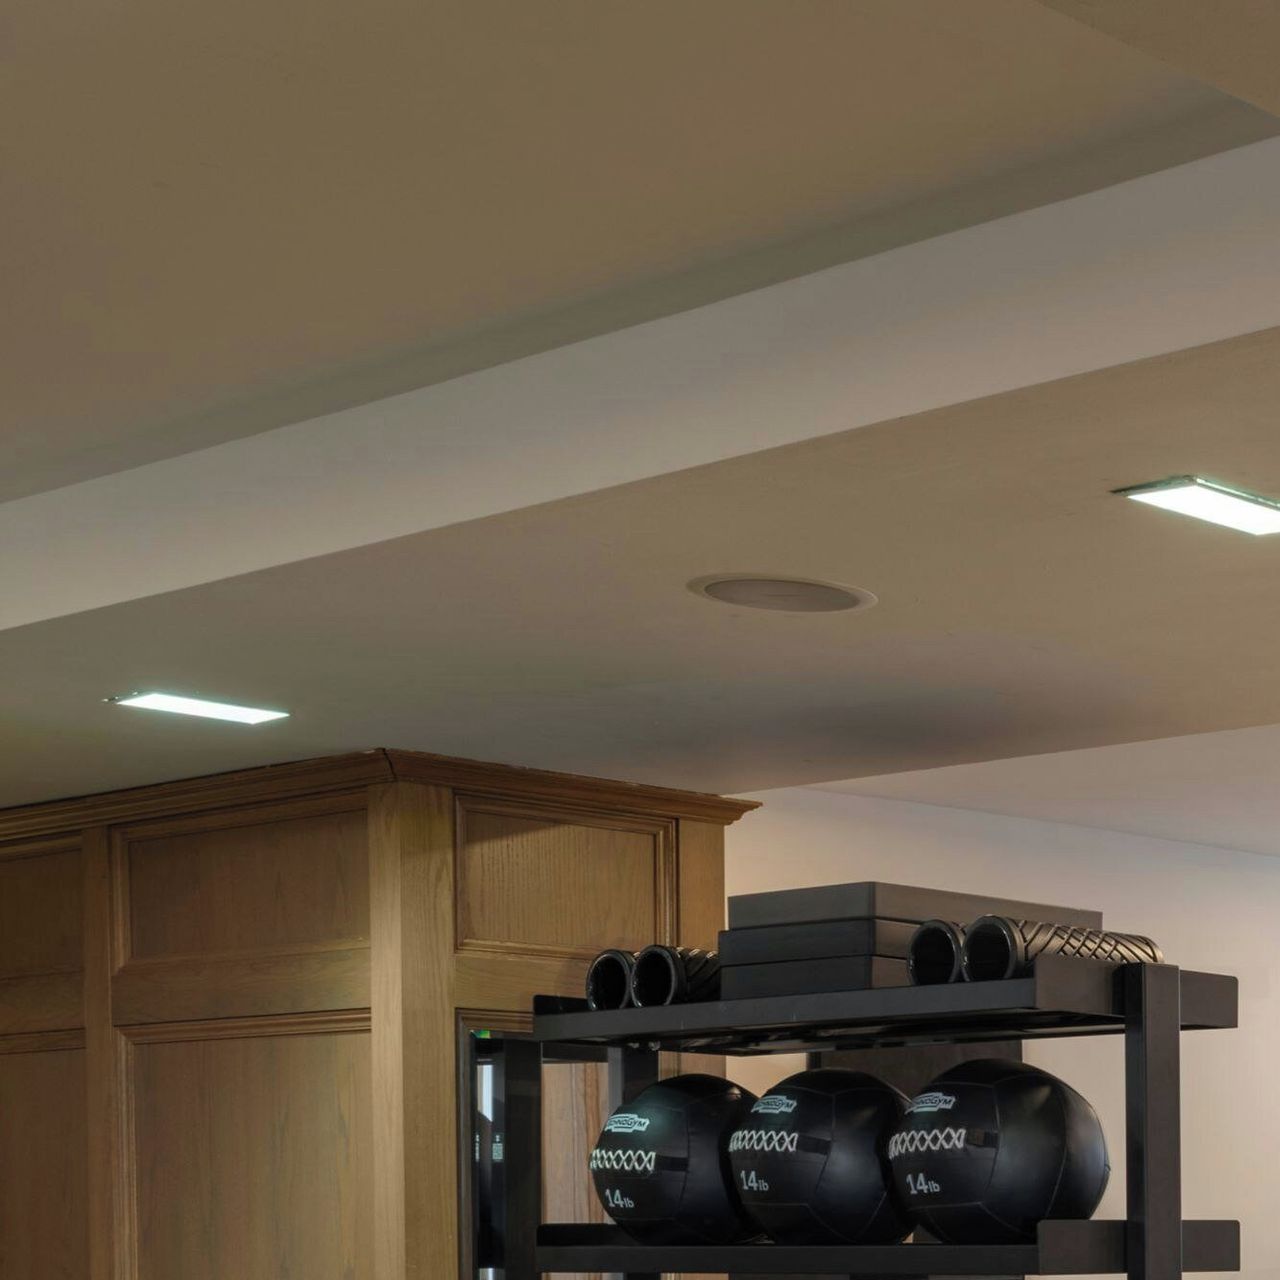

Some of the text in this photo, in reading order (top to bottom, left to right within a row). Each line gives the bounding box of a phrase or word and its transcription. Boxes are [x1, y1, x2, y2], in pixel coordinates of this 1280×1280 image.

[740, 1170, 769, 1191] 14lb
[906, 1172, 941, 1194] 14lb
[605, 1188, 634, 1208] 14lb
